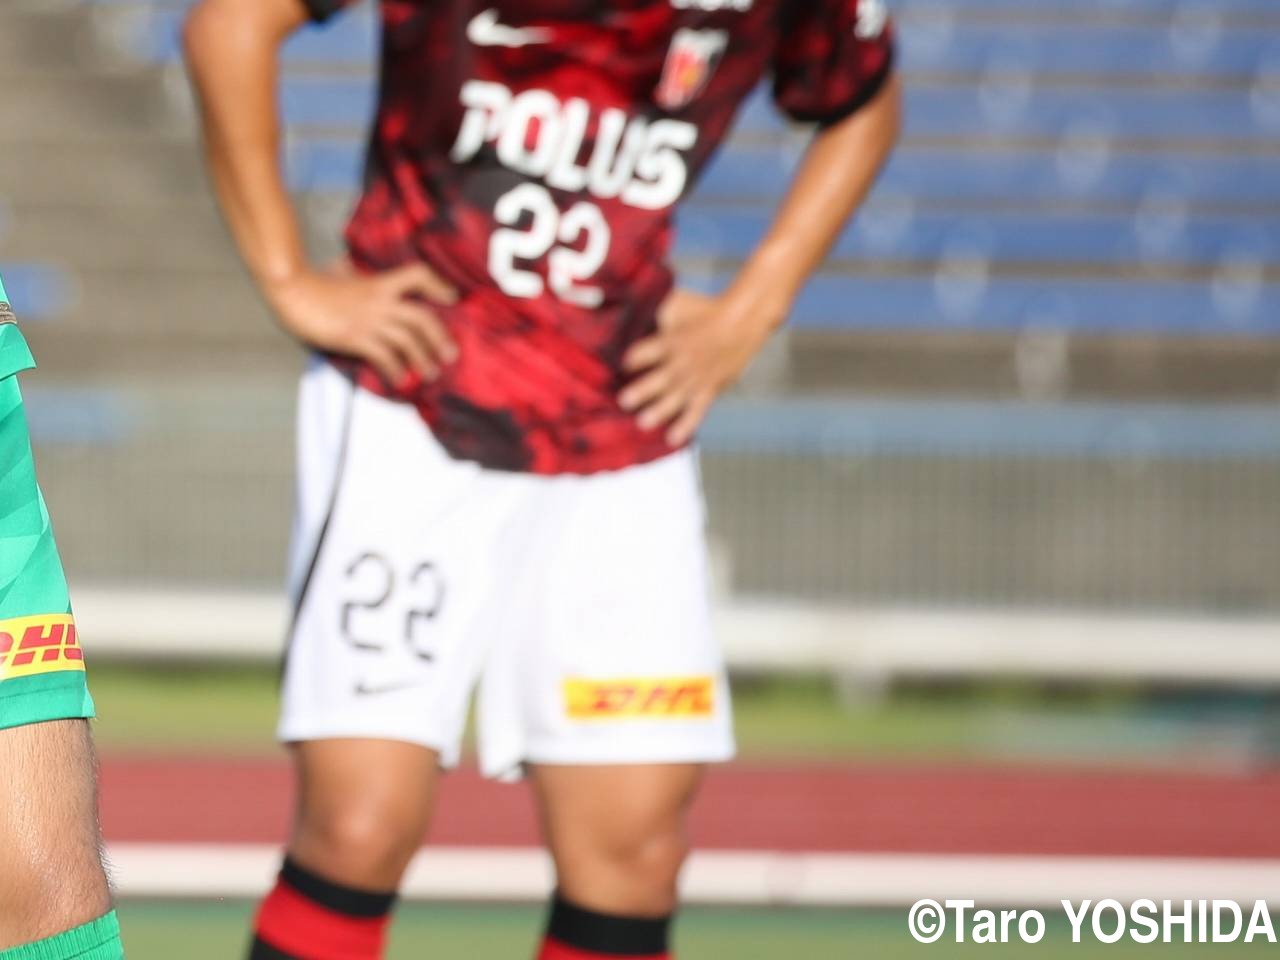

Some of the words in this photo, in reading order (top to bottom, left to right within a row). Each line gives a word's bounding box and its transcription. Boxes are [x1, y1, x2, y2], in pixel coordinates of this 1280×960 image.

[451, 79, 699, 211] POLUS
[488, 183, 611, 308] 22
[339, 551, 447, 662] 22
